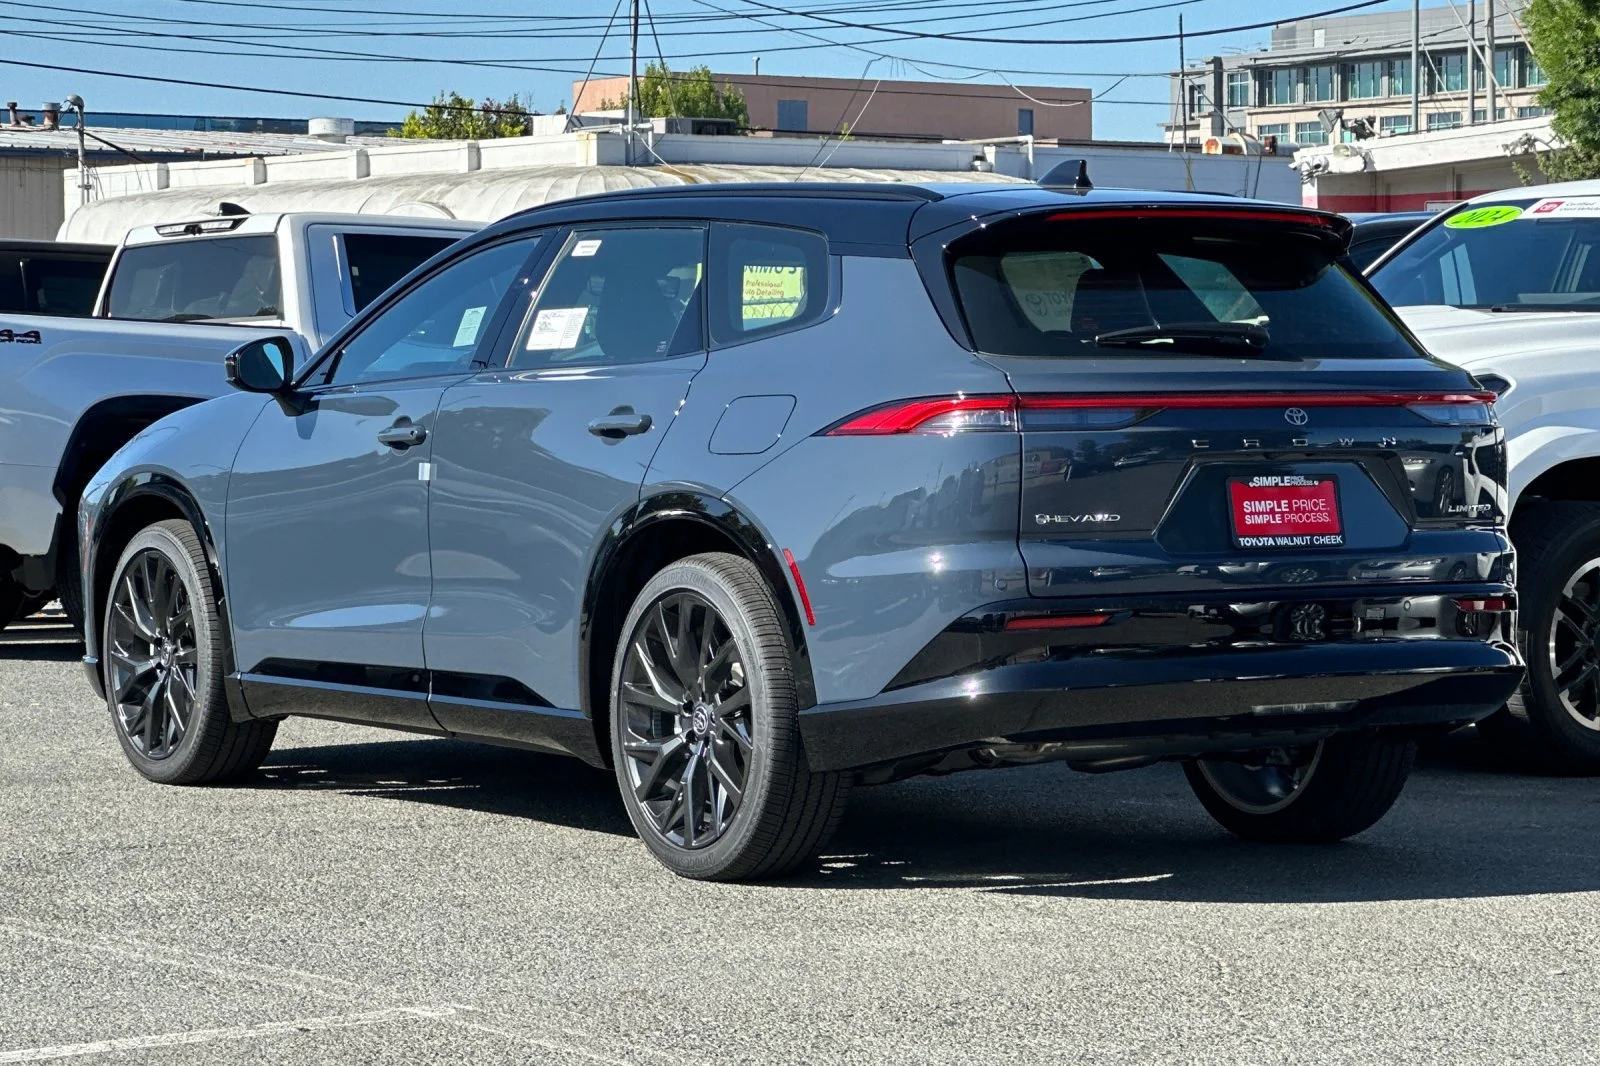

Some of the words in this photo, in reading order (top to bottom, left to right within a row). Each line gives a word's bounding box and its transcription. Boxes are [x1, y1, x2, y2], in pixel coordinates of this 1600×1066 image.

[1449, 210, 1517, 224] 2024
[745, 280, 783, 288] Professional
[756, 289, 785, 297] Detailing
[1191, 437, 1397, 448] CROWN
[1253, 476, 1291, 487] SIMPLE
[1243, 500, 1289, 513] SIMPLE
[1292, 499, 1330, 511] PRICE.
[1448, 503, 1491, 513] LIMITED
[1245, 514, 1282, 525] SIMPLE
[1284, 512, 1331, 523] PROCESS.
[1239, 537, 1275, 546] TOYOTA
[1275, 536, 1311, 545] WALNUT
